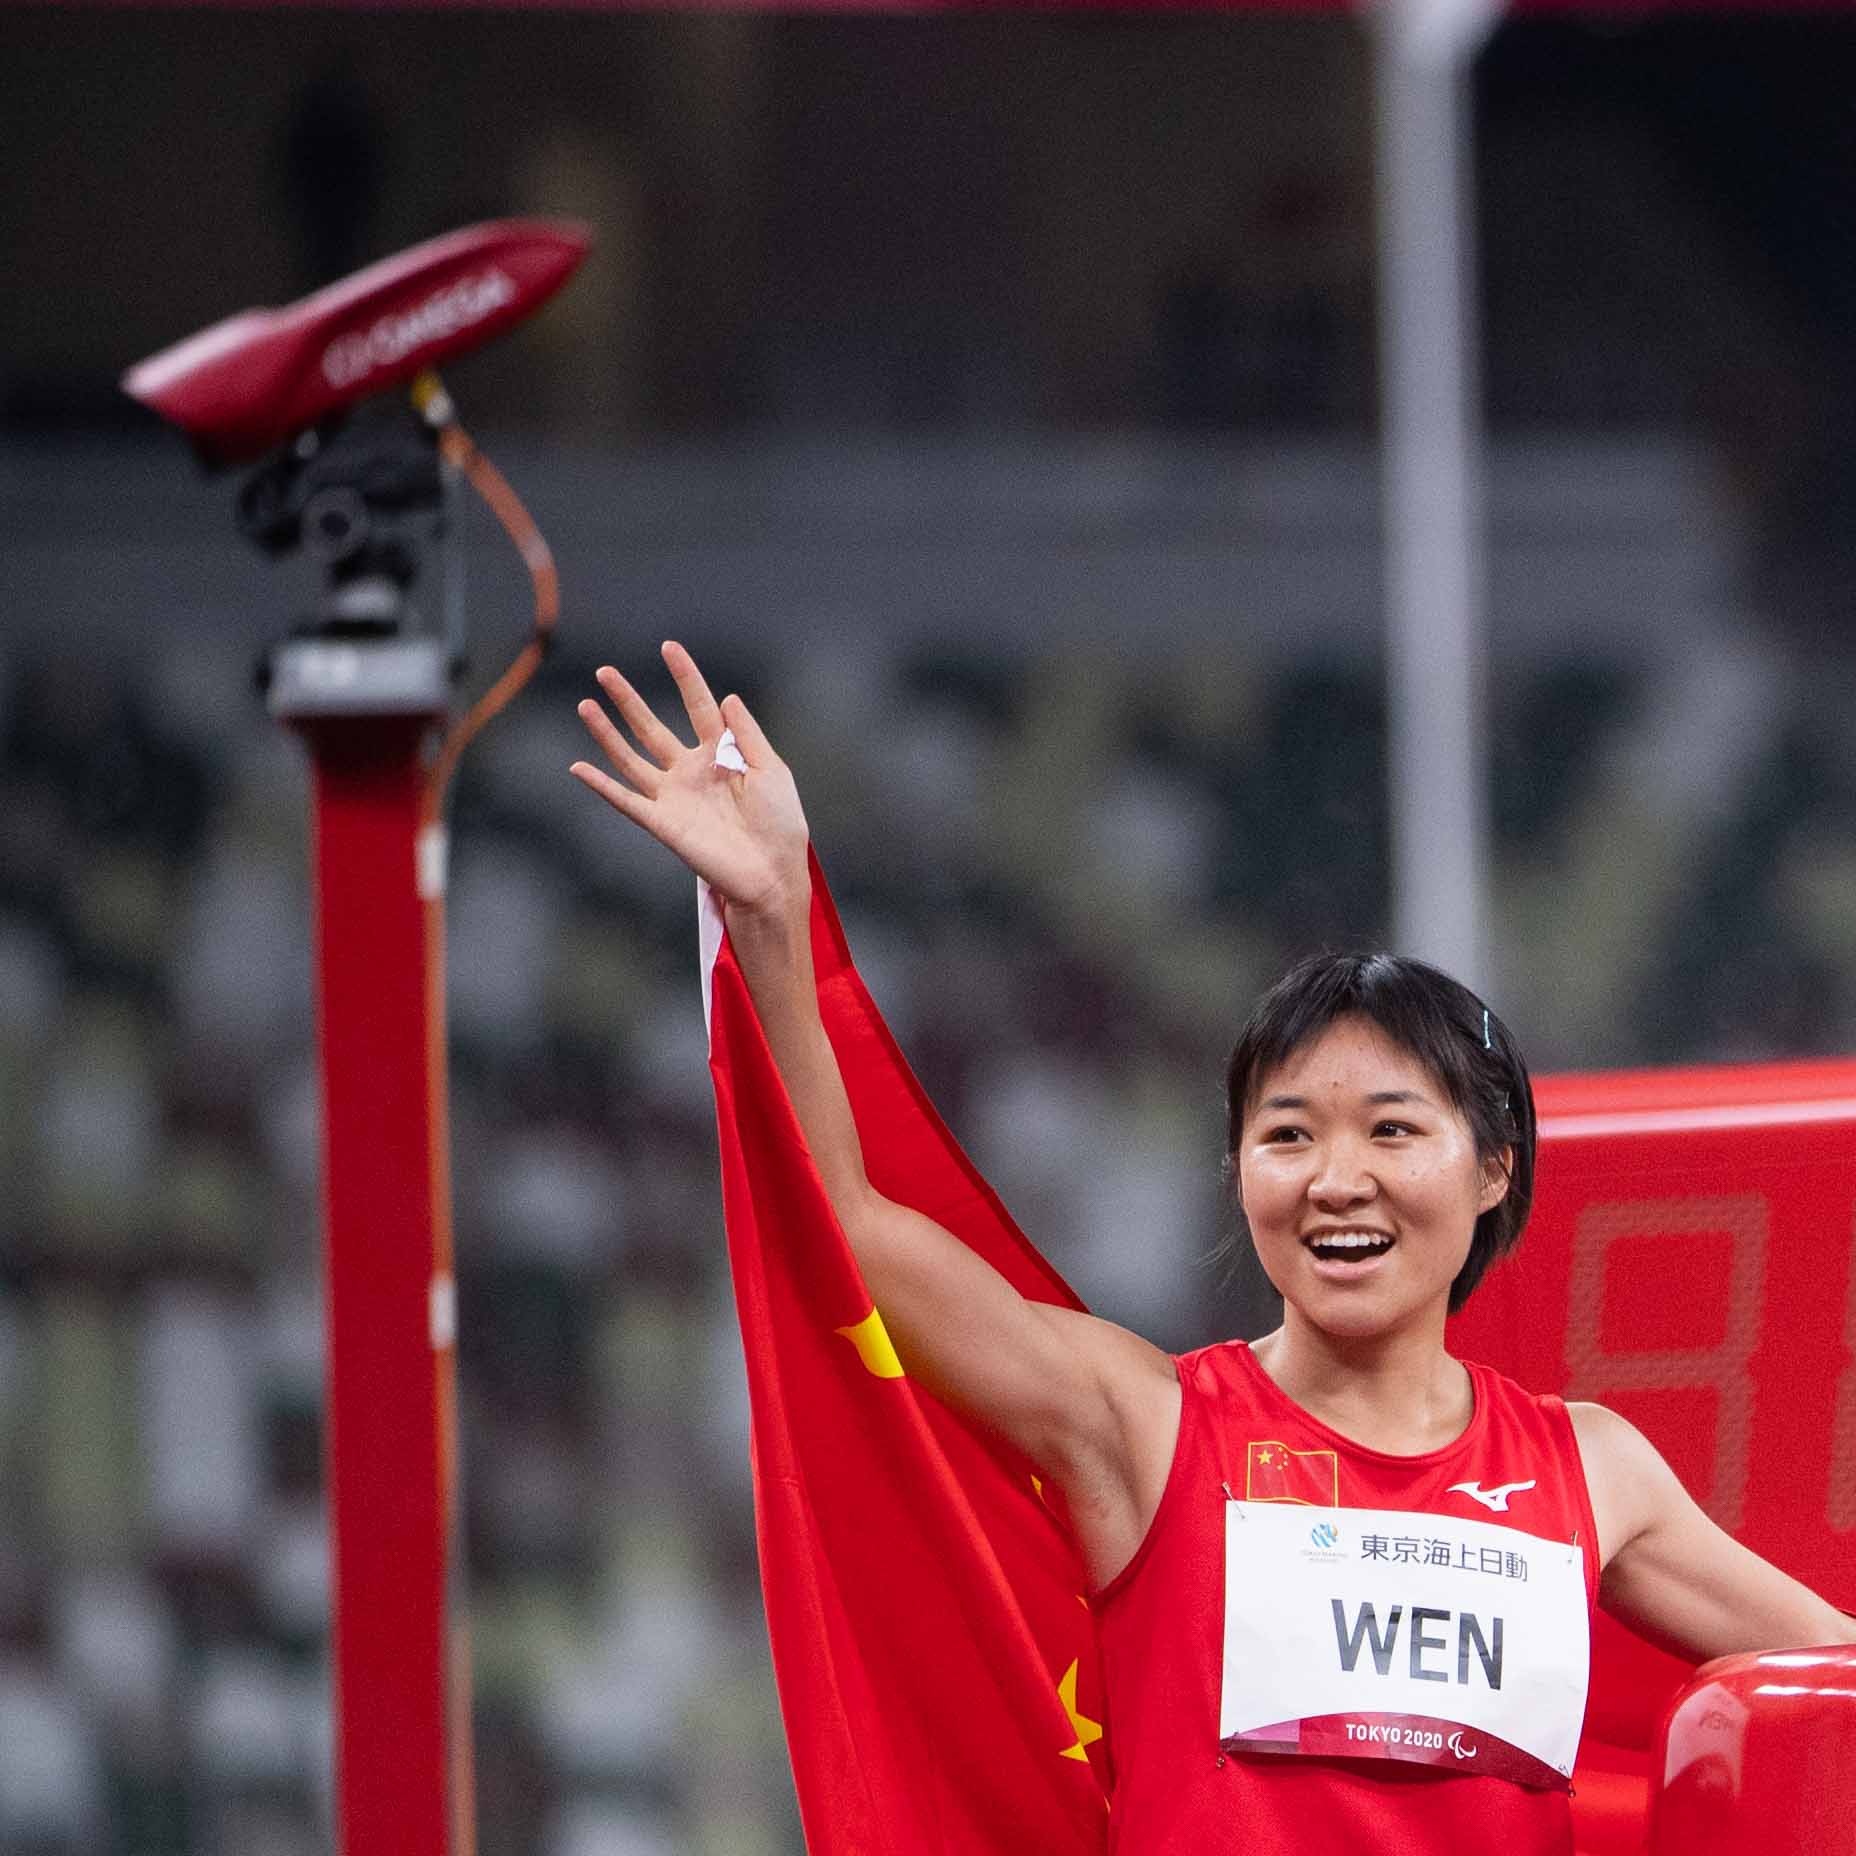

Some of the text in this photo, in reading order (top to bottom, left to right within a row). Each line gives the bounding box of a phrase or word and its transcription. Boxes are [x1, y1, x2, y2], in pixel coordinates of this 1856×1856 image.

[1360, 1534, 1528, 1583] 東京海上日動
[1330, 1598, 1505, 1692] WEN
[1345, 1723, 1443, 1749] TOKYO 2020
